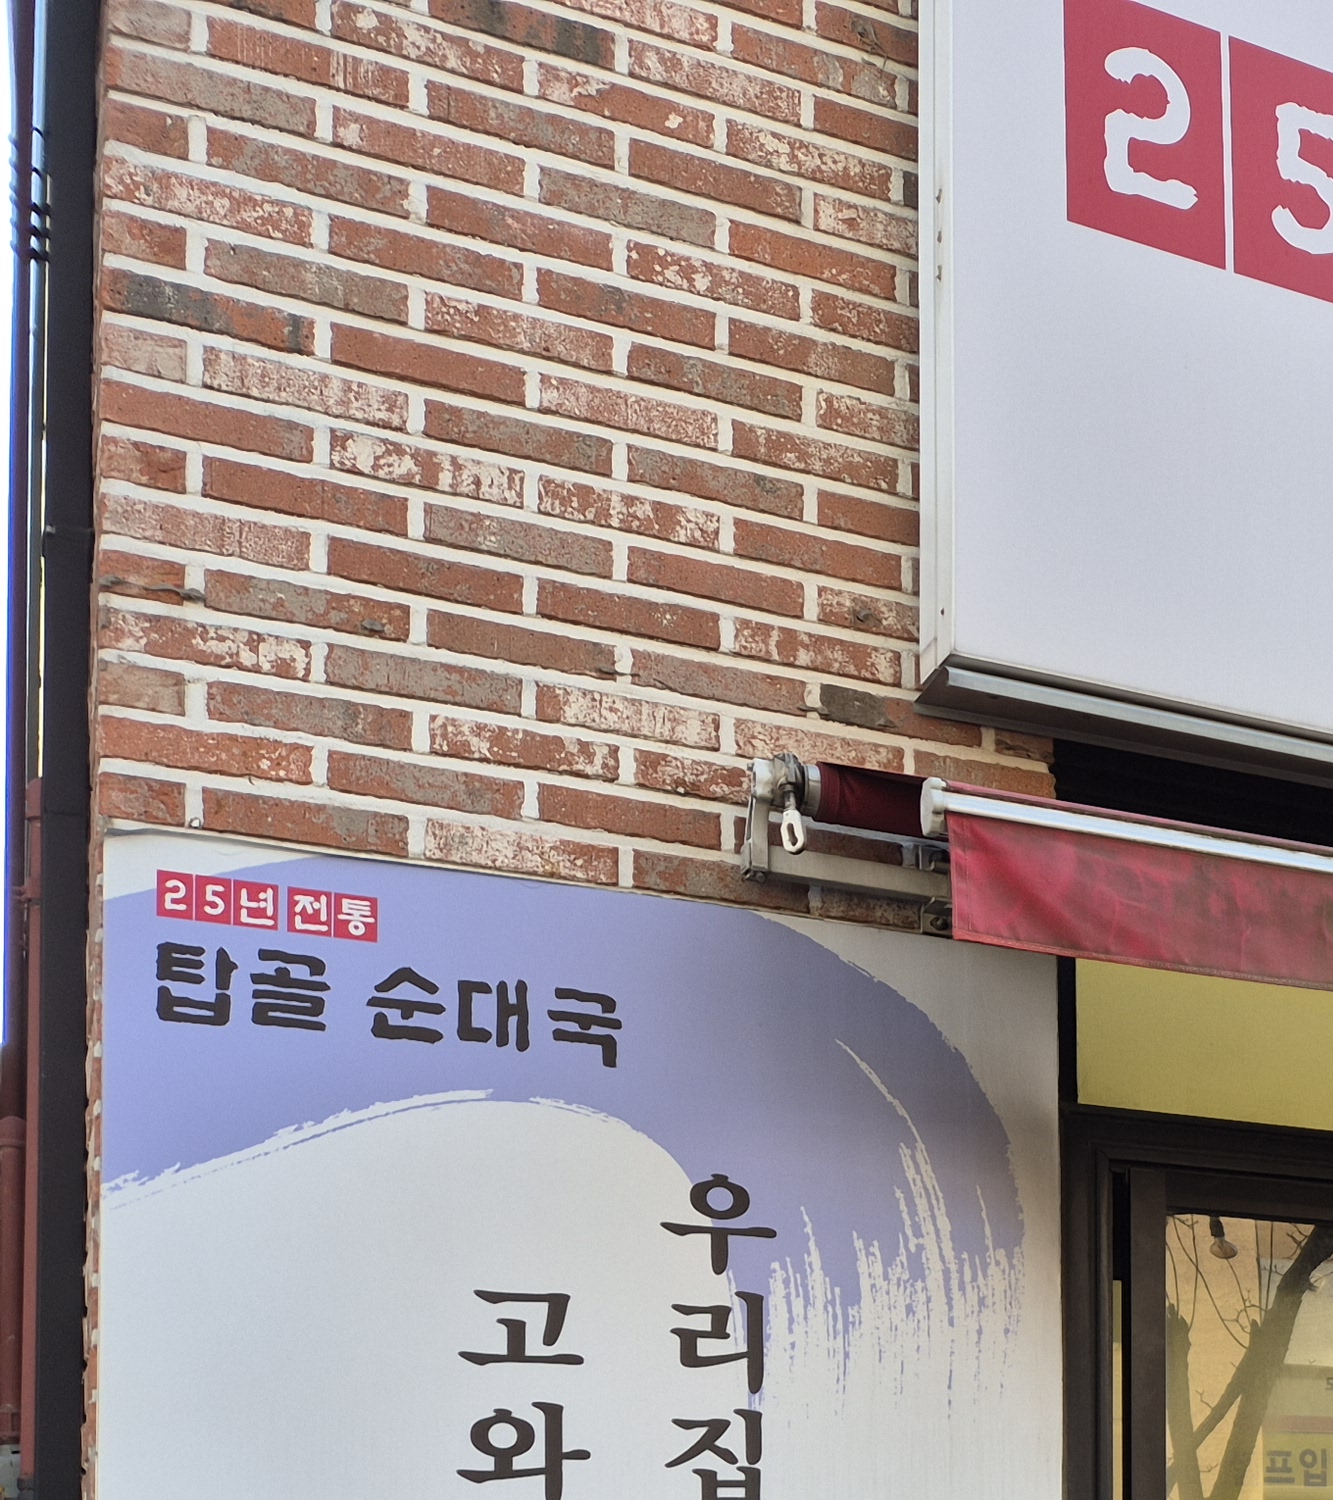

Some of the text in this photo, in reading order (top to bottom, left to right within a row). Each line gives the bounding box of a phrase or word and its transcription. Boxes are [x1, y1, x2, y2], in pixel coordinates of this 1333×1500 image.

[163, 878, 376, 936] 25년 전통
[156, 941, 623, 1068] 탑골 순대국
